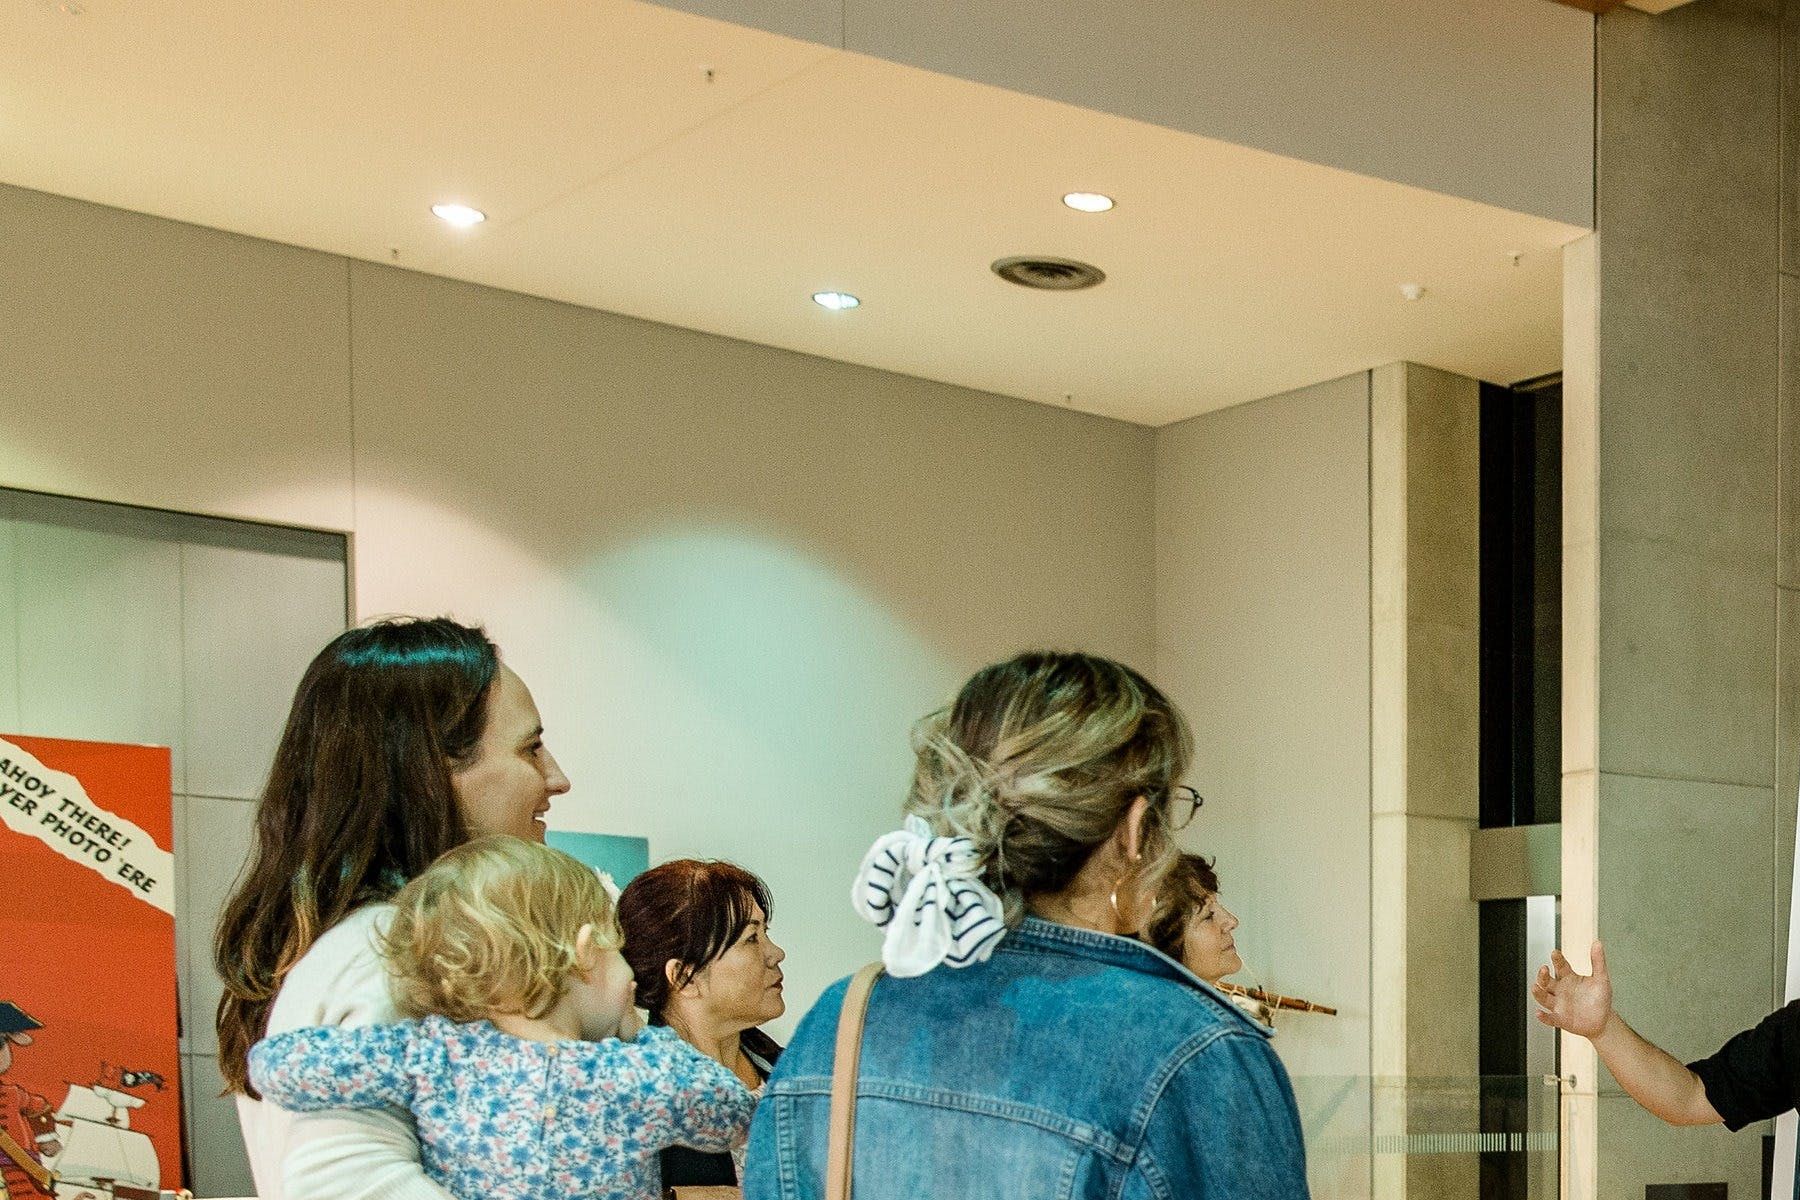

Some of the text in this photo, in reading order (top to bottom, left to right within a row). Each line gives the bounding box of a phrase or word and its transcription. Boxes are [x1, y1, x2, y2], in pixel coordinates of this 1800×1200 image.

[0, 758, 132, 851] AHOY THERE!
[0, 782, 38, 816] YER
[40, 811, 112, 863] PHOTO
